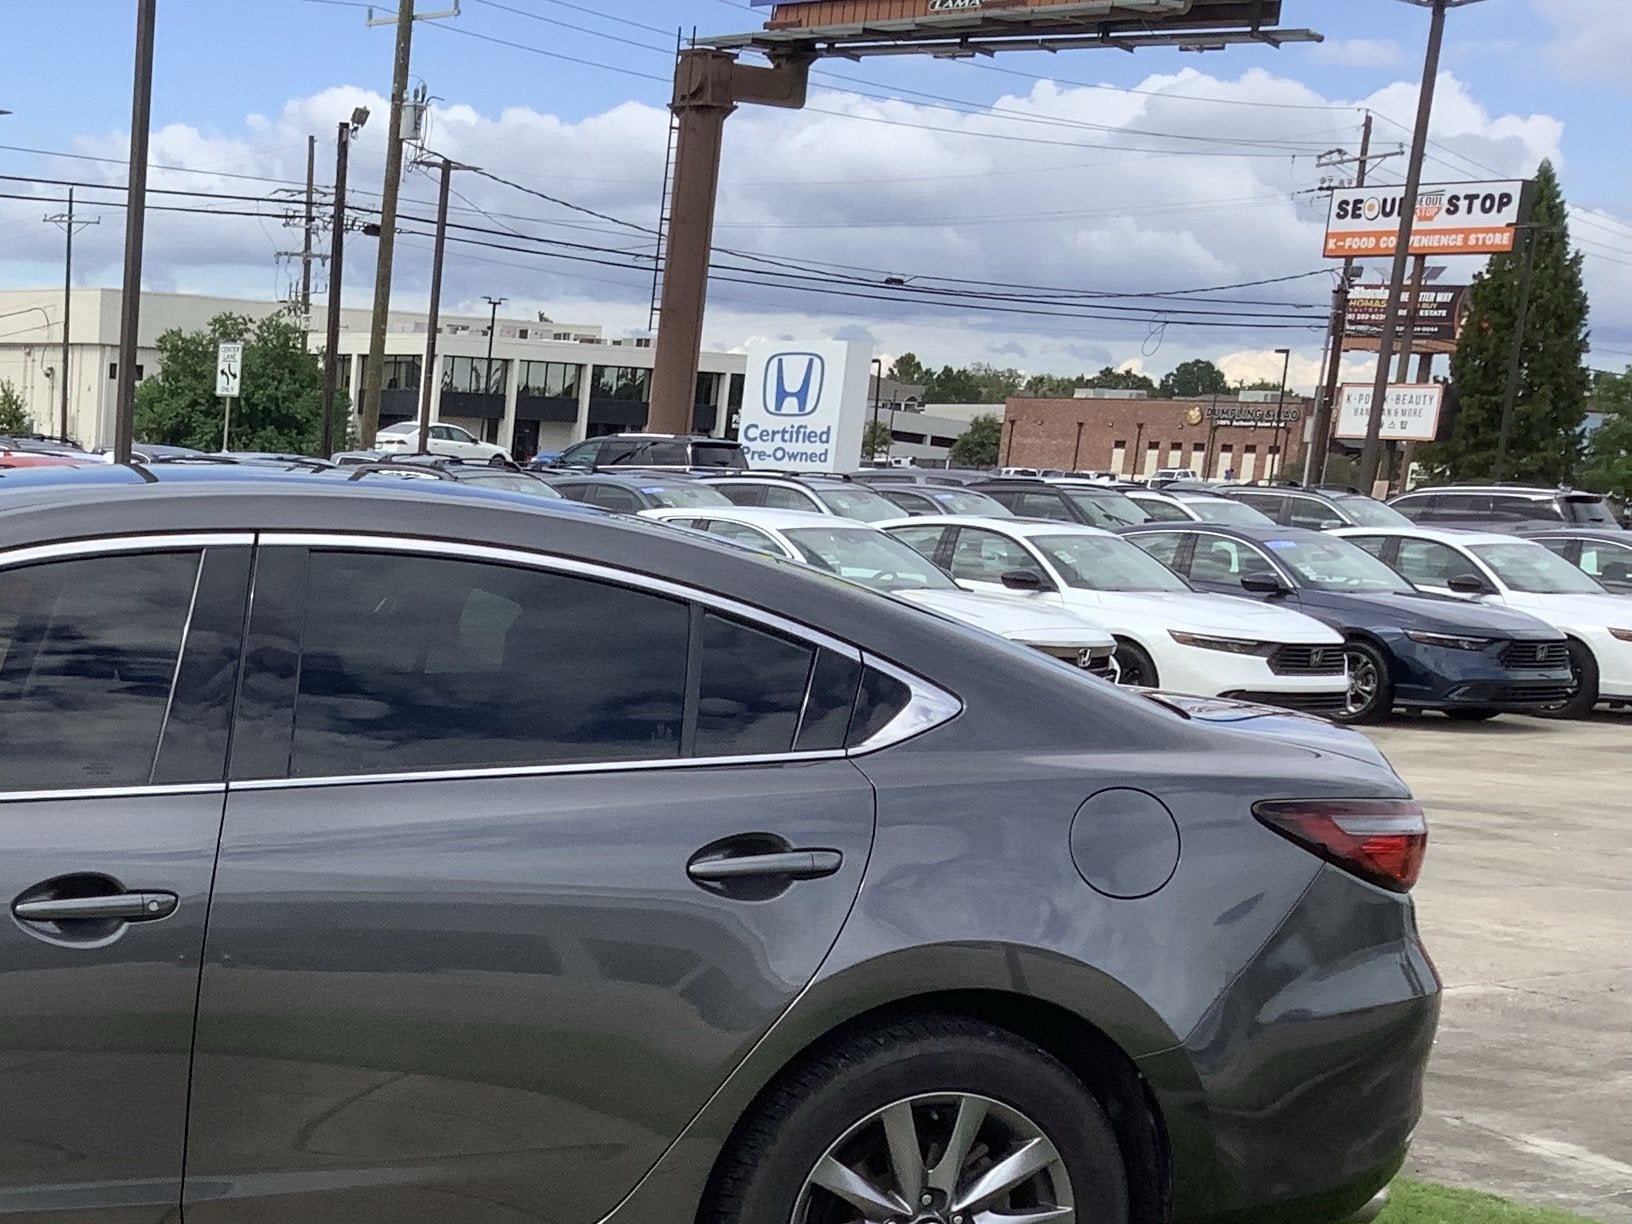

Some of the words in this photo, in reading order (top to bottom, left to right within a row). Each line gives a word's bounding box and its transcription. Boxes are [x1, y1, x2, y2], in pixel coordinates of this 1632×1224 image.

[1445, 192, 1513, 216] STOP
[1327, 236, 1376, 250] K-FOOD
[1379, 232, 1465, 248] COENIENCE
[1467, 232, 1511, 246] STORE
[1348, 299, 1388, 308] HOMAS
[1346, 393, 1371, 405] K-PO
[1206, 407, 1263, 420] DUMPLING
[743, 423, 831, 445] Certified
[742, 446, 828, 463] Pre-Owned
